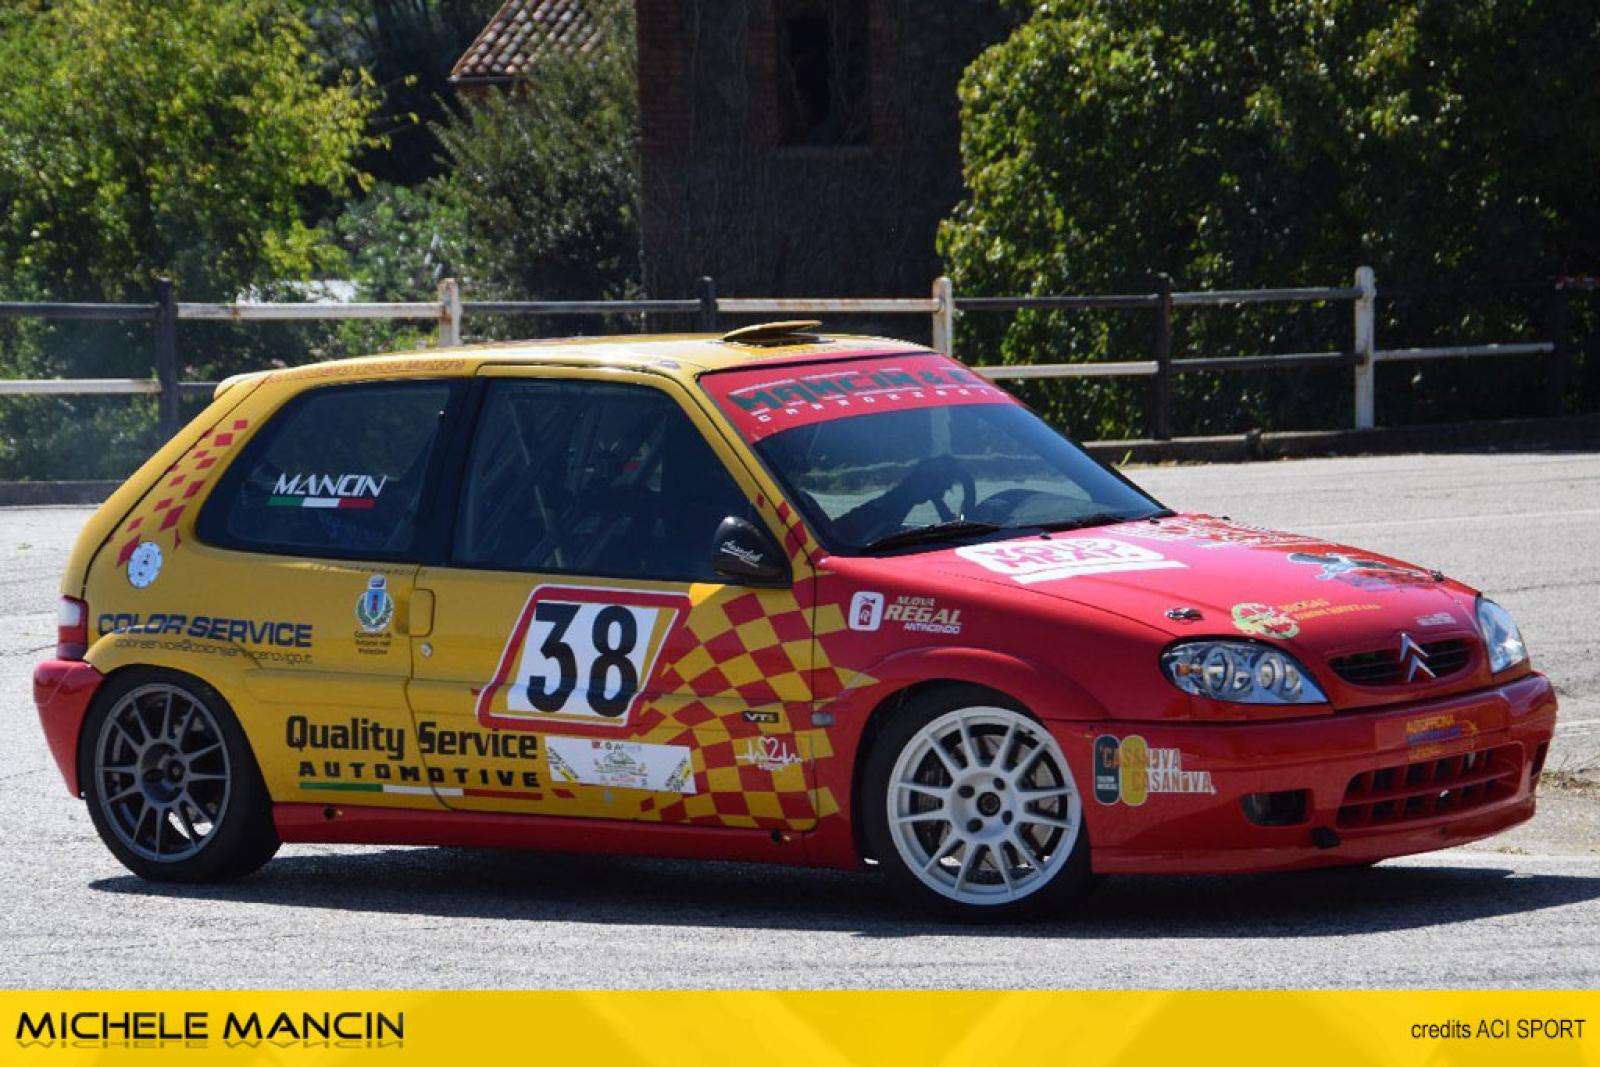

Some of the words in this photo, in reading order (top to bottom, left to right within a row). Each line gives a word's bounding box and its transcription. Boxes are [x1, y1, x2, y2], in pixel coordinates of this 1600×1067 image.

[272, 472, 388, 497] MANCIN
[97, 613, 188, 637] COLOR
[187, 616, 313, 648] SERVICE
[884, 604, 962, 626] REGAL
[526, 602, 638, 718] 38
[286, 715, 405, 761] Quality
[419, 721, 538, 759] Service
[298, 761, 541, 788] AUTOMOTIVE
